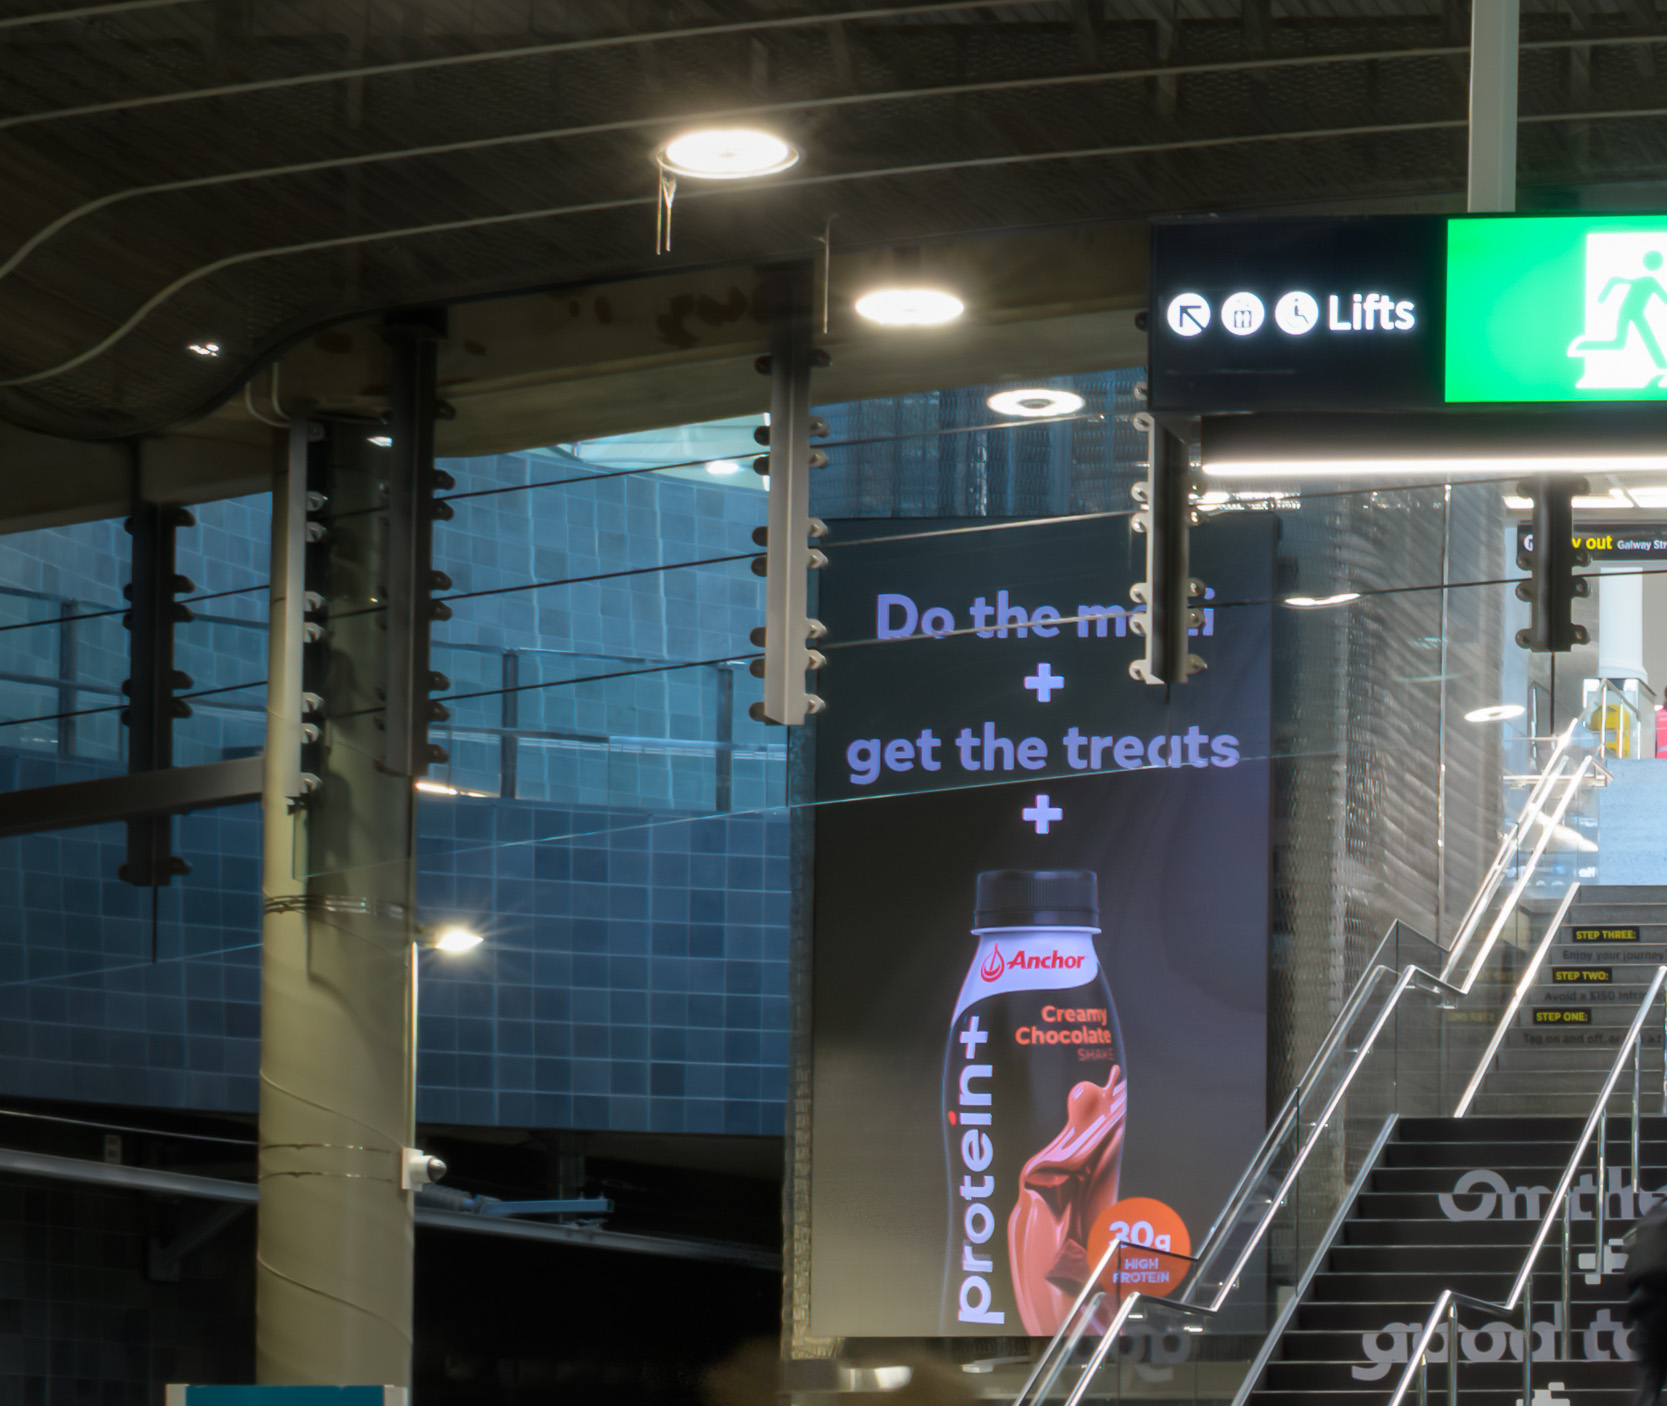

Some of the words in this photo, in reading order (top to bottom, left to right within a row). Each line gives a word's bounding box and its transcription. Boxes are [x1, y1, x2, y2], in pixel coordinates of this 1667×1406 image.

[1328, 294, 1415, 332] Lifts
[1586, 534, 1613, 551] out
[1616, 539, 1651, 552] Galway
[877, 593, 955, 641] Do
[969, 590, 1061, 638] the
[1077, 587, 1215, 638] mi
[846, 728, 942, 786] get
[955, 722, 1049, 771] the
[1062, 725, 1240, 771] treats
[1575, 930, 1600, 940] STEP
[1602, 930, 1637, 940] THREE:
[1006, 950, 1086, 970] Anchor
[1562, 950, 1593, 962] Enjoy
[1596, 952, 1620, 962] your
[1555, 972, 1581, 981] STEP
[1582, 972, 1609, 981] TWO:
[1545, 991, 1579, 1001] Avoid
[1041, 1005, 1108, 1027] Creamy
[1536, 1012, 1561, 1022] STEP
[1563, 1012, 1588, 1022] ONE:
[1015, 1026, 1112, 1046] Chocolate
[1523, 1033, 1543, 1045] Tap
[1563, 1033, 1584, 1044] and
[949, 1014, 1005, 1324] protein+
[1439, 1169, 1554, 1222] On
[1108, 1220, 1172, 1252] 30g
[1124, 1258, 1159, 1271] HIGH
